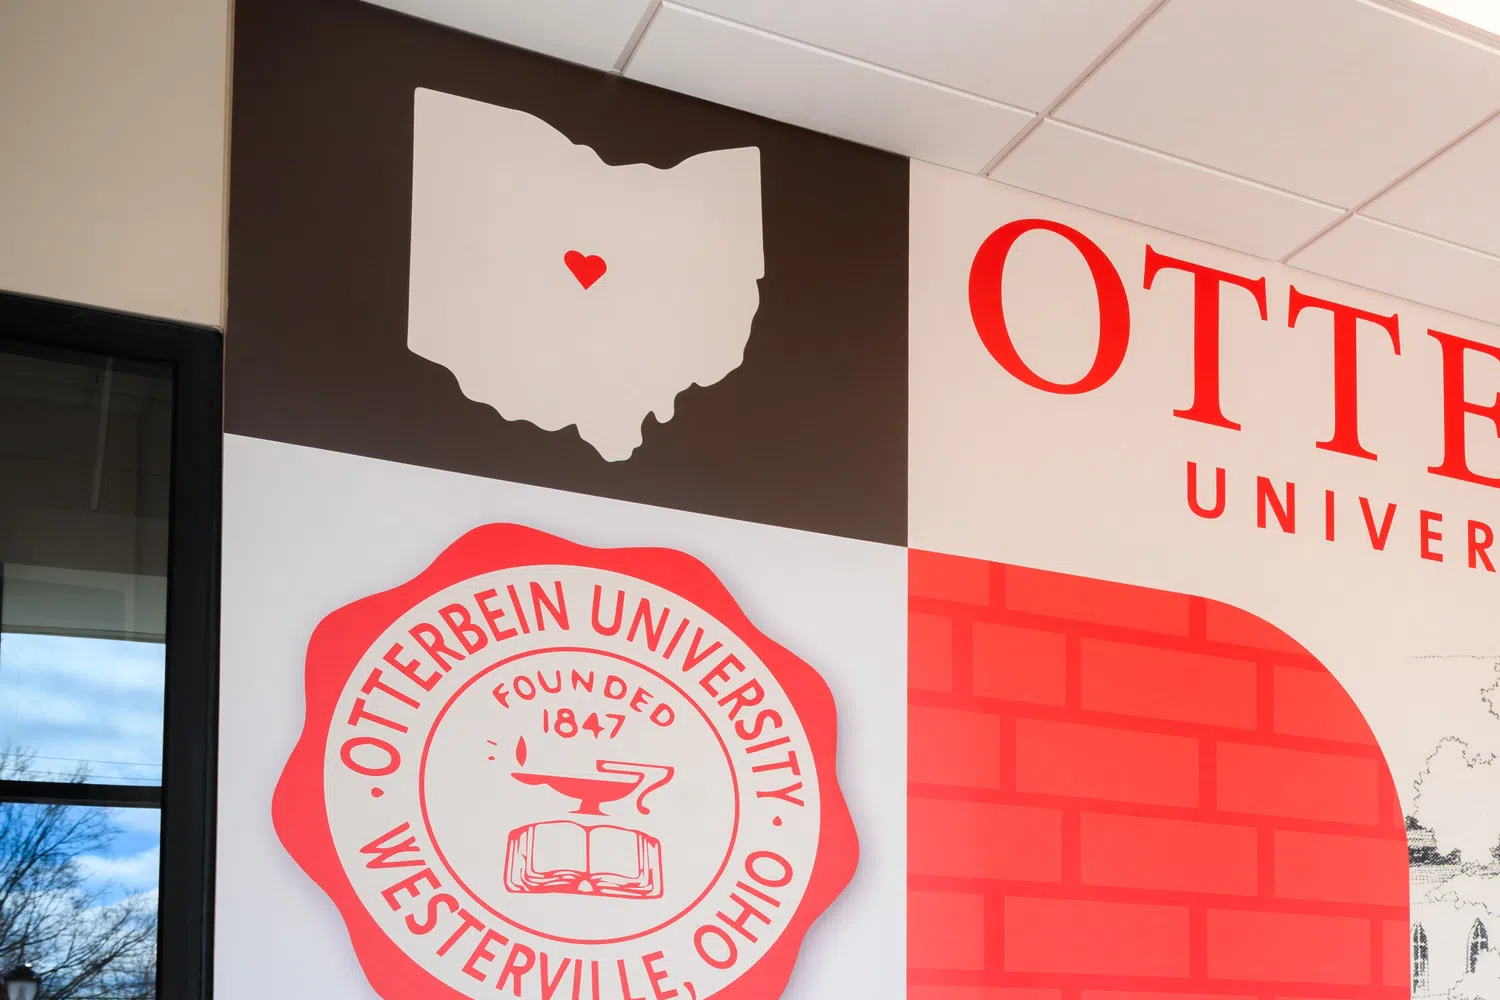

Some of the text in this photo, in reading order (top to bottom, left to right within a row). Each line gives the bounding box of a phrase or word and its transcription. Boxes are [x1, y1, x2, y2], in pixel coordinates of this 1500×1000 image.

[340, 580, 805, 808] OTTERBEIN UNIVERSITY
[491, 668, 675, 728] FOUNDED
[542, 708, 627, 739] 1847
[693, 849, 794, 970] OHIO
